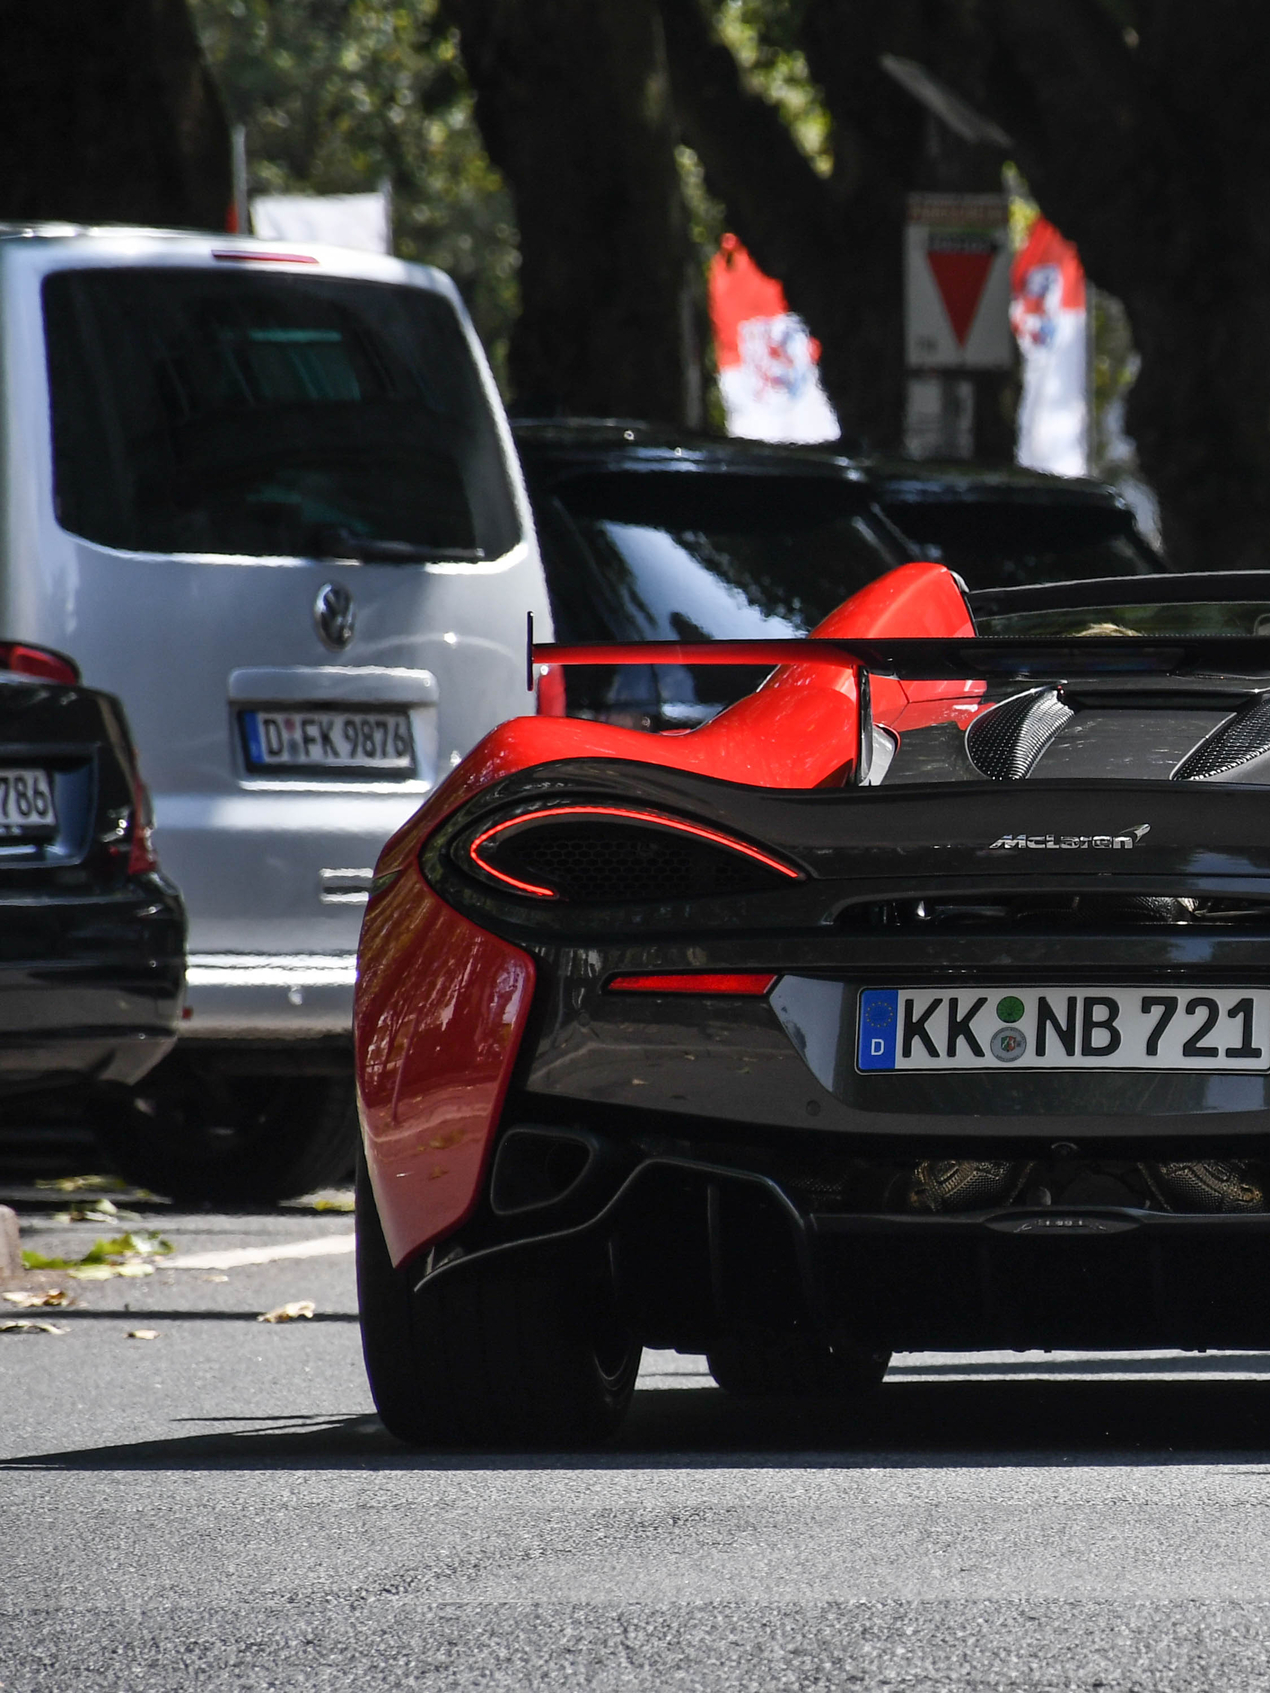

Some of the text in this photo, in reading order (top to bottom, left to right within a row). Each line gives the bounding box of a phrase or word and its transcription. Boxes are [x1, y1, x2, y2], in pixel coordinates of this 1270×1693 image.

[263, 718, 284, 756] D
[301, 718, 340, 758] FK
[344, 718, 408, 758] 9876
[0, 773, 49, 818] 786
[989, 833, 1133, 849] McLaren
[870, 1038, 885, 1056] D
[902, 996, 1263, 1058] KK NB 721
